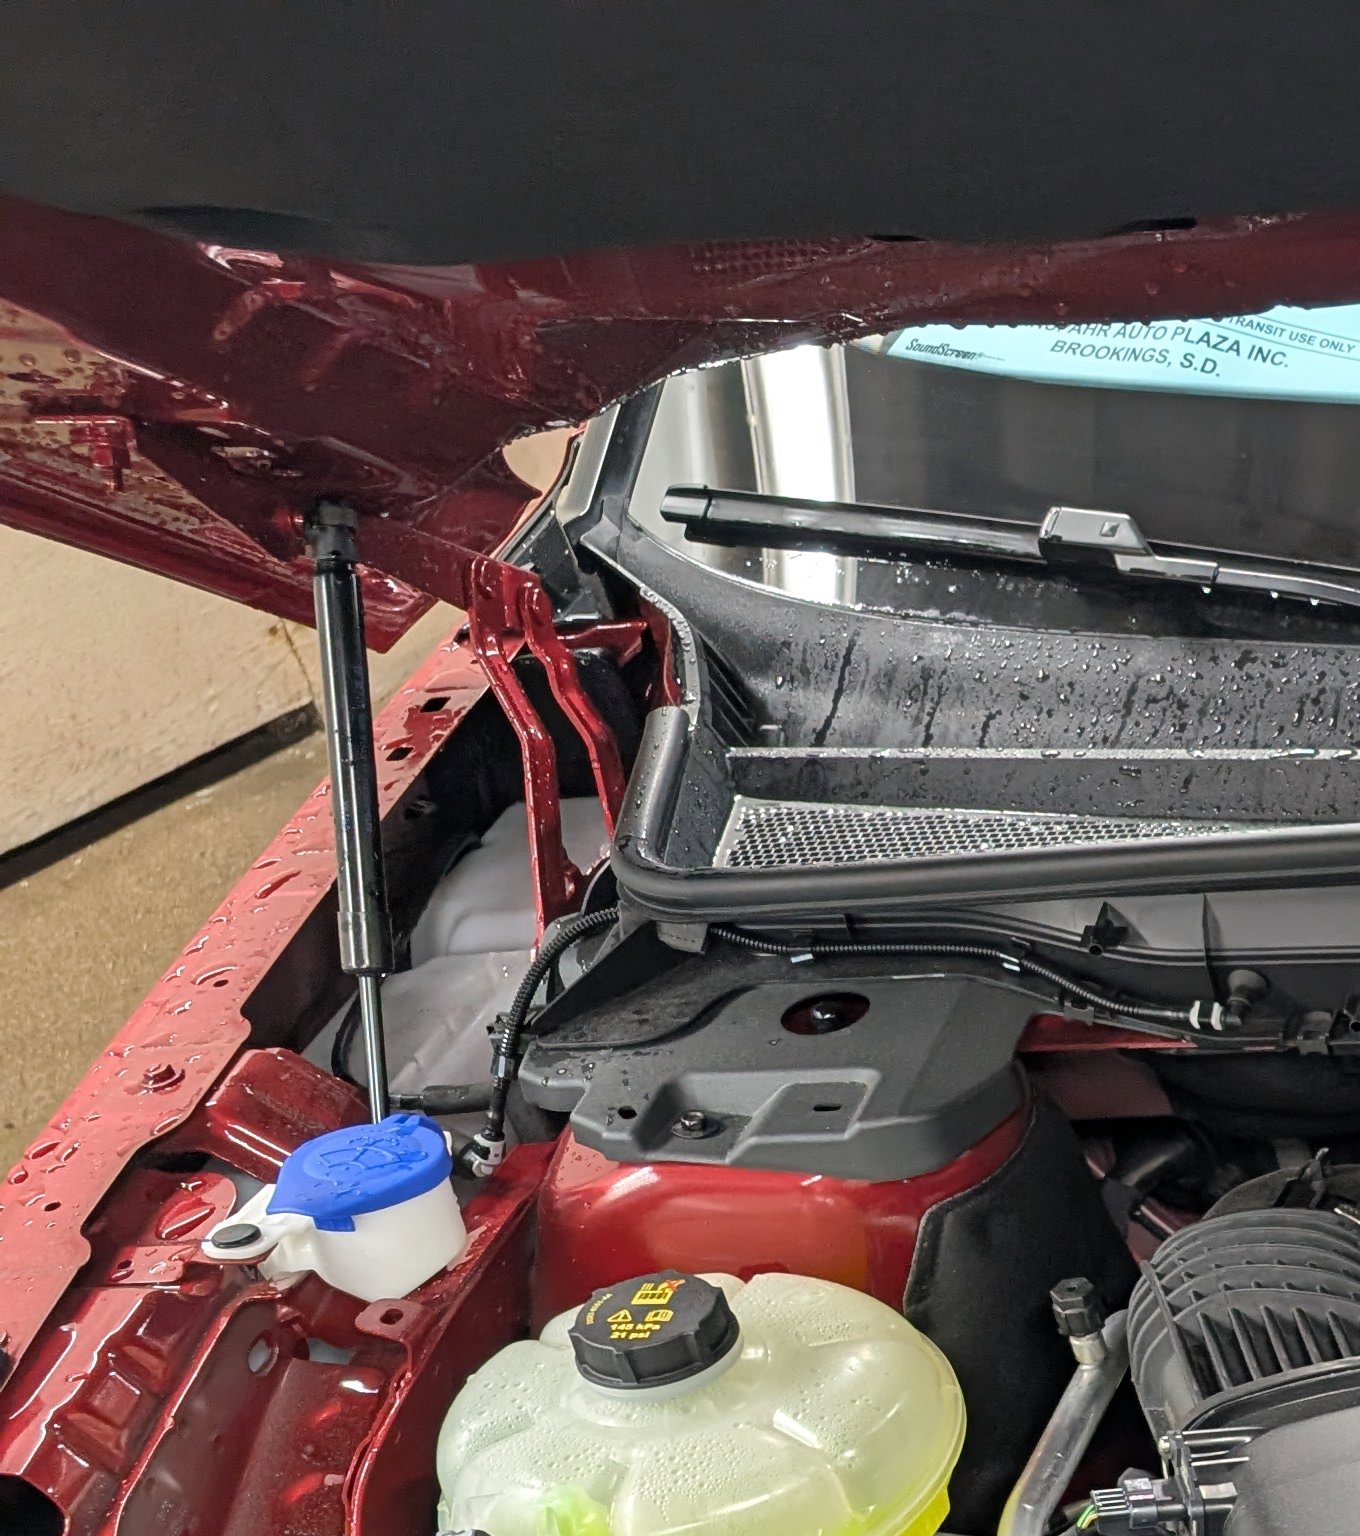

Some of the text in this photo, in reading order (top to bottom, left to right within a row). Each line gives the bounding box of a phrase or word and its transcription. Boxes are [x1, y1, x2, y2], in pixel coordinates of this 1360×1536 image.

[1113, 325, 1168, 340] AUTO
[1171, 326, 1241, 356] PLAZA
[1247, 345, 1289, 367] INC.
[1288, 330, 1316, 346] USE
[1319, 338, 1356, 354] ONLY
[1050, 340, 1221, 377] BROOKINGS, S.D.
[609, 1331, 651, 1340] 21 psi
[610, 1323, 661, 1331] 145 kPa
